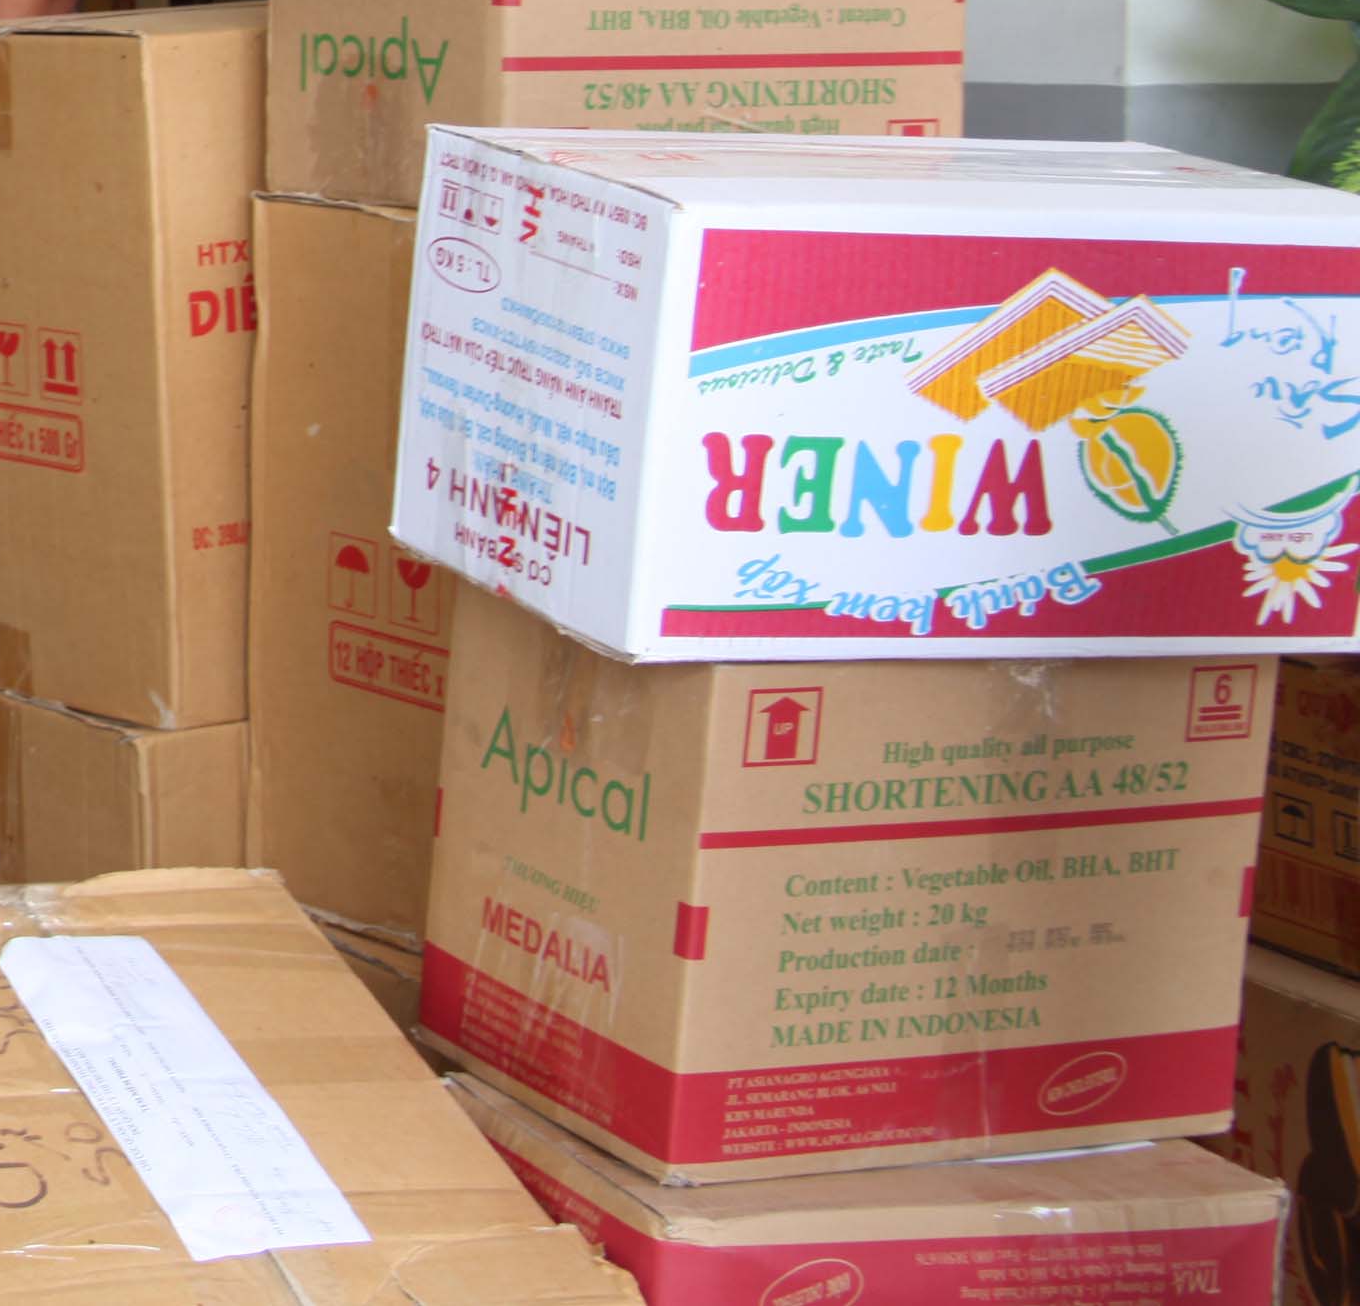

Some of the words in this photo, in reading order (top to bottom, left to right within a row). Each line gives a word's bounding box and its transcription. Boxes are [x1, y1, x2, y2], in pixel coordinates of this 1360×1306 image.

[587, 10, 632, 31] BHT
[736, 5, 822, 29] Vegetable
[839, 7, 906, 28] Content
[300, 16, 448, 105] Apical
[583, 83, 652, 110] 48/52
[658, 82, 698, 105] AA
[707, 78, 896, 109] SHORTENING
[197, 239, 248, 267] HTX
[436, 247, 454, 270] KG
[187, 275, 258, 338] DIÊ
[828, 350, 844, 374] &
[851, 336, 923, 368] Taste
[697, 353, 818, 398] Delicious
[38, 430, 61, 457] 500
[427, 457, 440, 491] 4
[703, 432, 1052, 538] WINER
[450, 468, 508, 526] ANH
[521, 502, 591, 566] LIÊN
[734, 554, 820, 606] xốp
[944, 562, 1101, 630] Bánh
[826, 591, 935, 636] kem
[333, 642, 351, 670] 12
[1213, 674, 1233, 704] 6
[773, 722, 793, 736] UP
[882, 740, 934, 770] High
[941, 737, 1014, 768] quality
[1052, 733, 1135, 761] purpose
[481, 704, 651, 841] Apical
[802, 771, 1047, 815] SHORTENING
[1058, 769, 1103, 800] AA
[1111, 760, 1191, 796] 48/52
[785, 872, 879, 899] Content
[902, 862, 1009, 895] Vegetable
[1128, 847, 1180, 875] BHT
[781, 911, 824, 937] Net
[829, 906, 905, 939] weight
[927, 902, 954, 928] 20
[959, 902, 988, 930] kg
[481, 895, 611, 994] MEDALIA
[778, 944, 906, 975] Production
[912, 940, 962, 965] date
[774, 984, 853, 1016] Expiry
[860, 980, 910, 1005] date
[933, 975, 958, 1001] 12
[963, 970, 1048, 999] Months
[770, 1020, 853, 1049] MADE
[860, 1017, 888, 1043] IN
[896, 1006, 1041, 1041] INDONESIA
